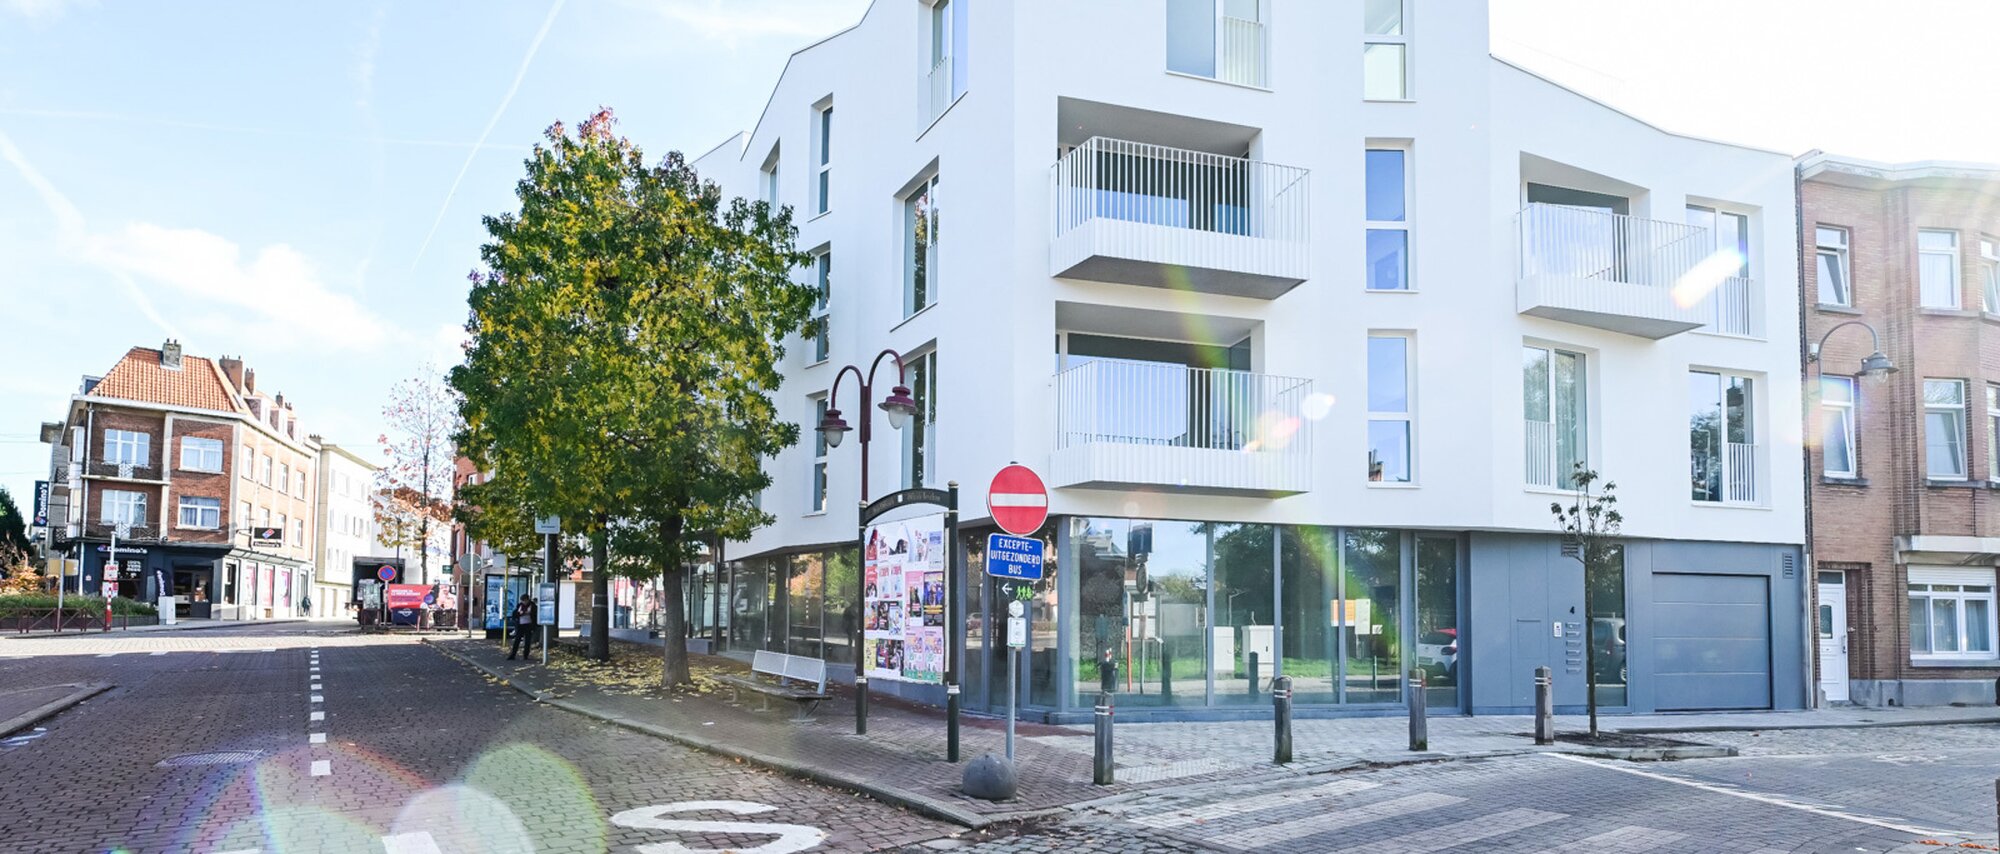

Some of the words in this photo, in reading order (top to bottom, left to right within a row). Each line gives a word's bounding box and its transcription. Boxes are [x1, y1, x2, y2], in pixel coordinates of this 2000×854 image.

[38, 483, 47, 517] Domino's
[1008, 563, 1022, 575] BUS
[1569, 606, 1575, 614] 4
